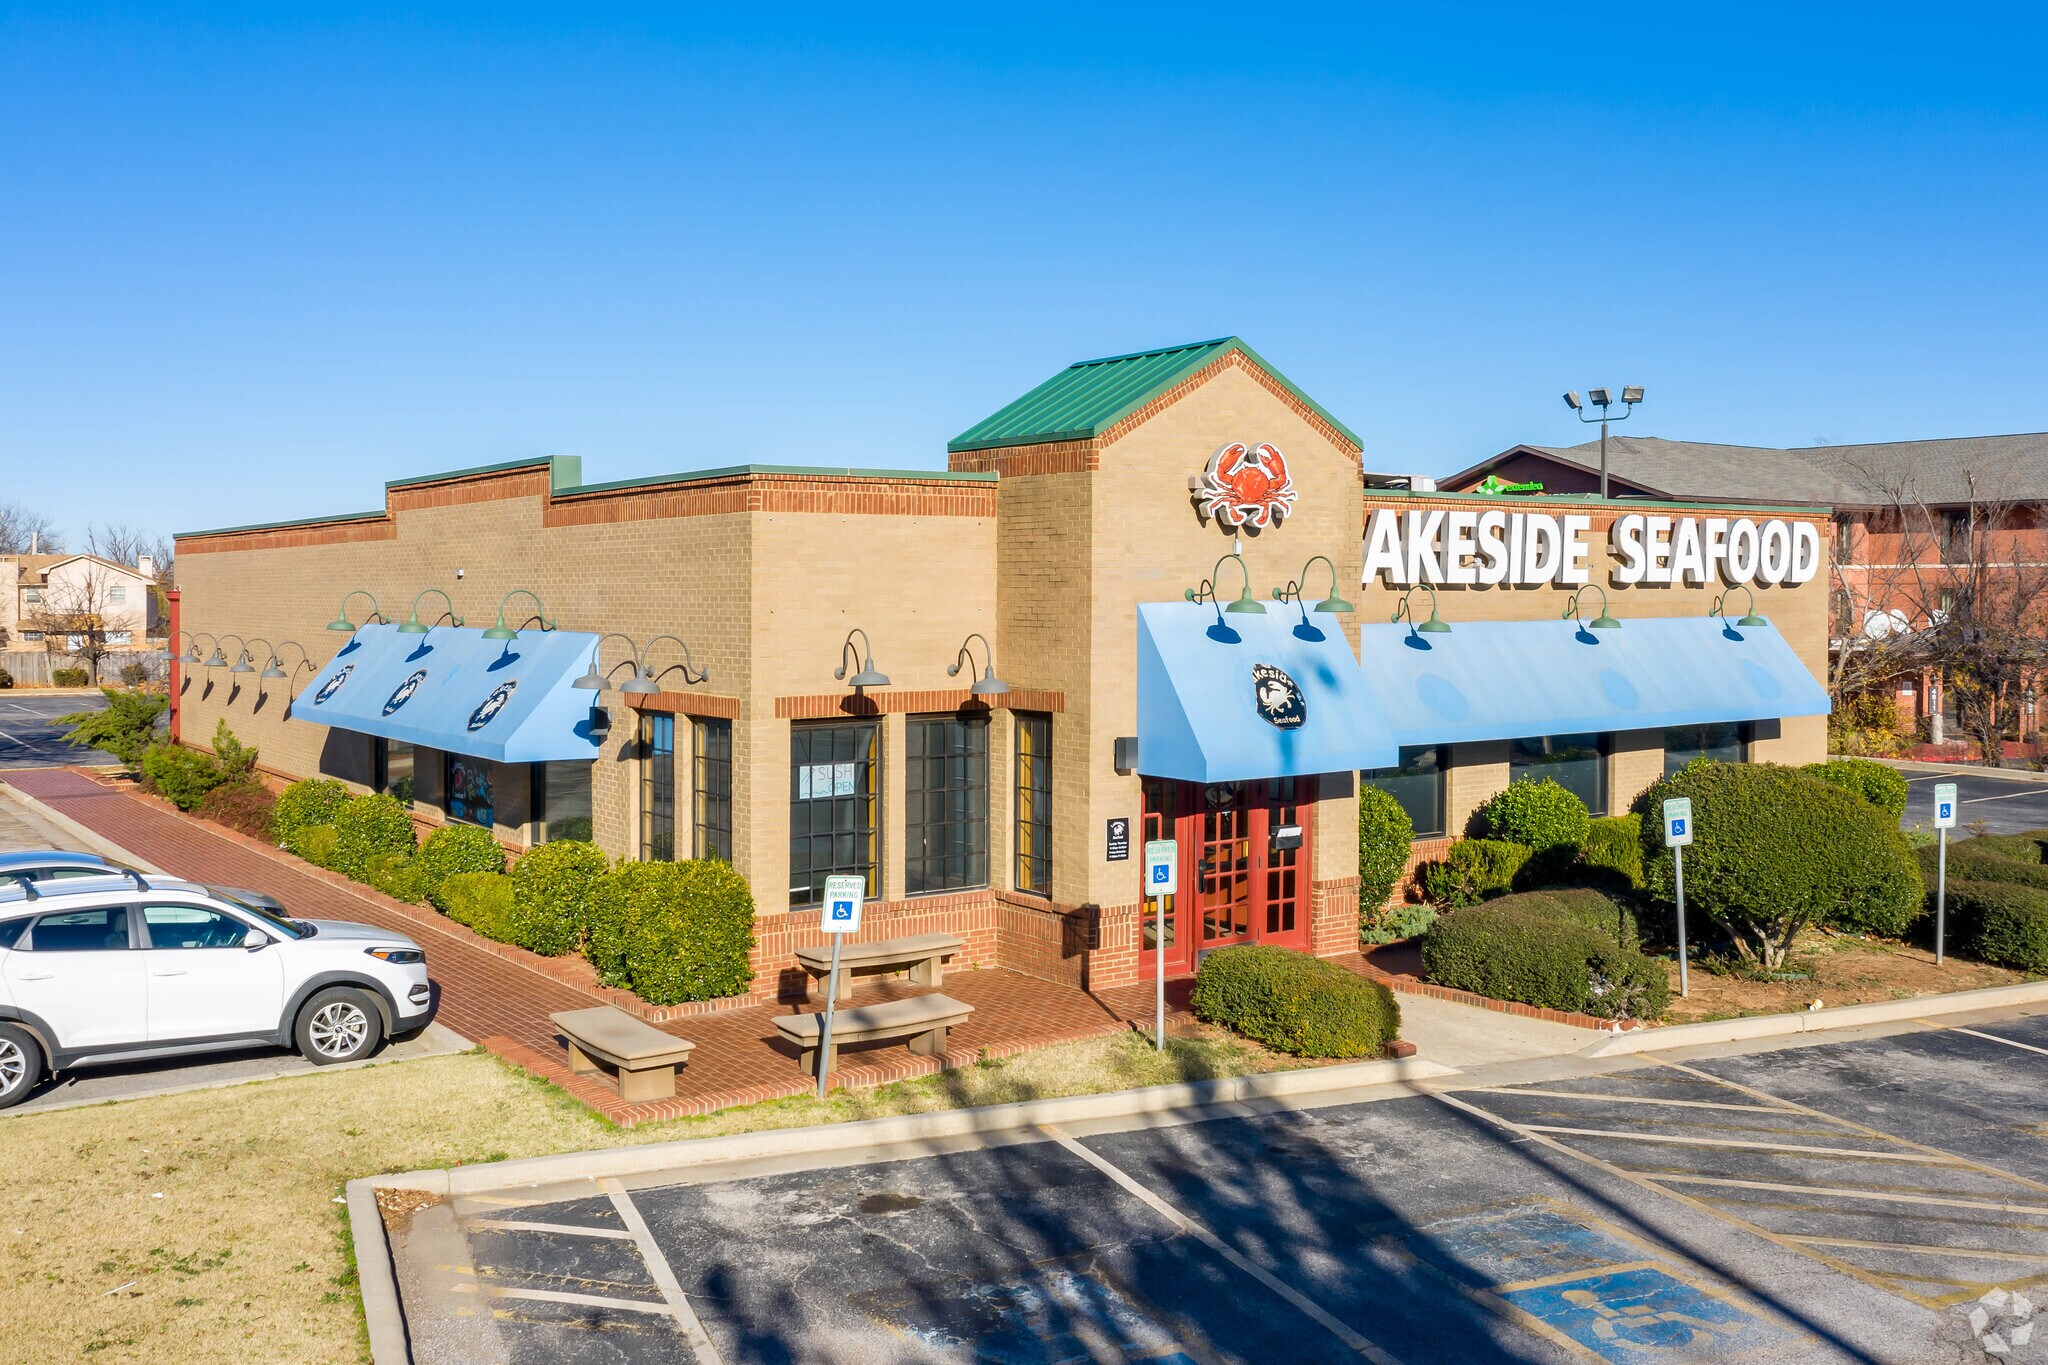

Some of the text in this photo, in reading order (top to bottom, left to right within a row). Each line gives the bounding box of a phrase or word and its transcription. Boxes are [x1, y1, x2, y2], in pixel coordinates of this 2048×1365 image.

[1362, 508, 1820, 585] AKESIDE SEAFOOD
[1273, 715, 1301, 724] Seafood
[818, 765, 853, 781] SUSH
[828, 781, 855, 792] OPEN
[829, 881, 862, 889] RESERVED
